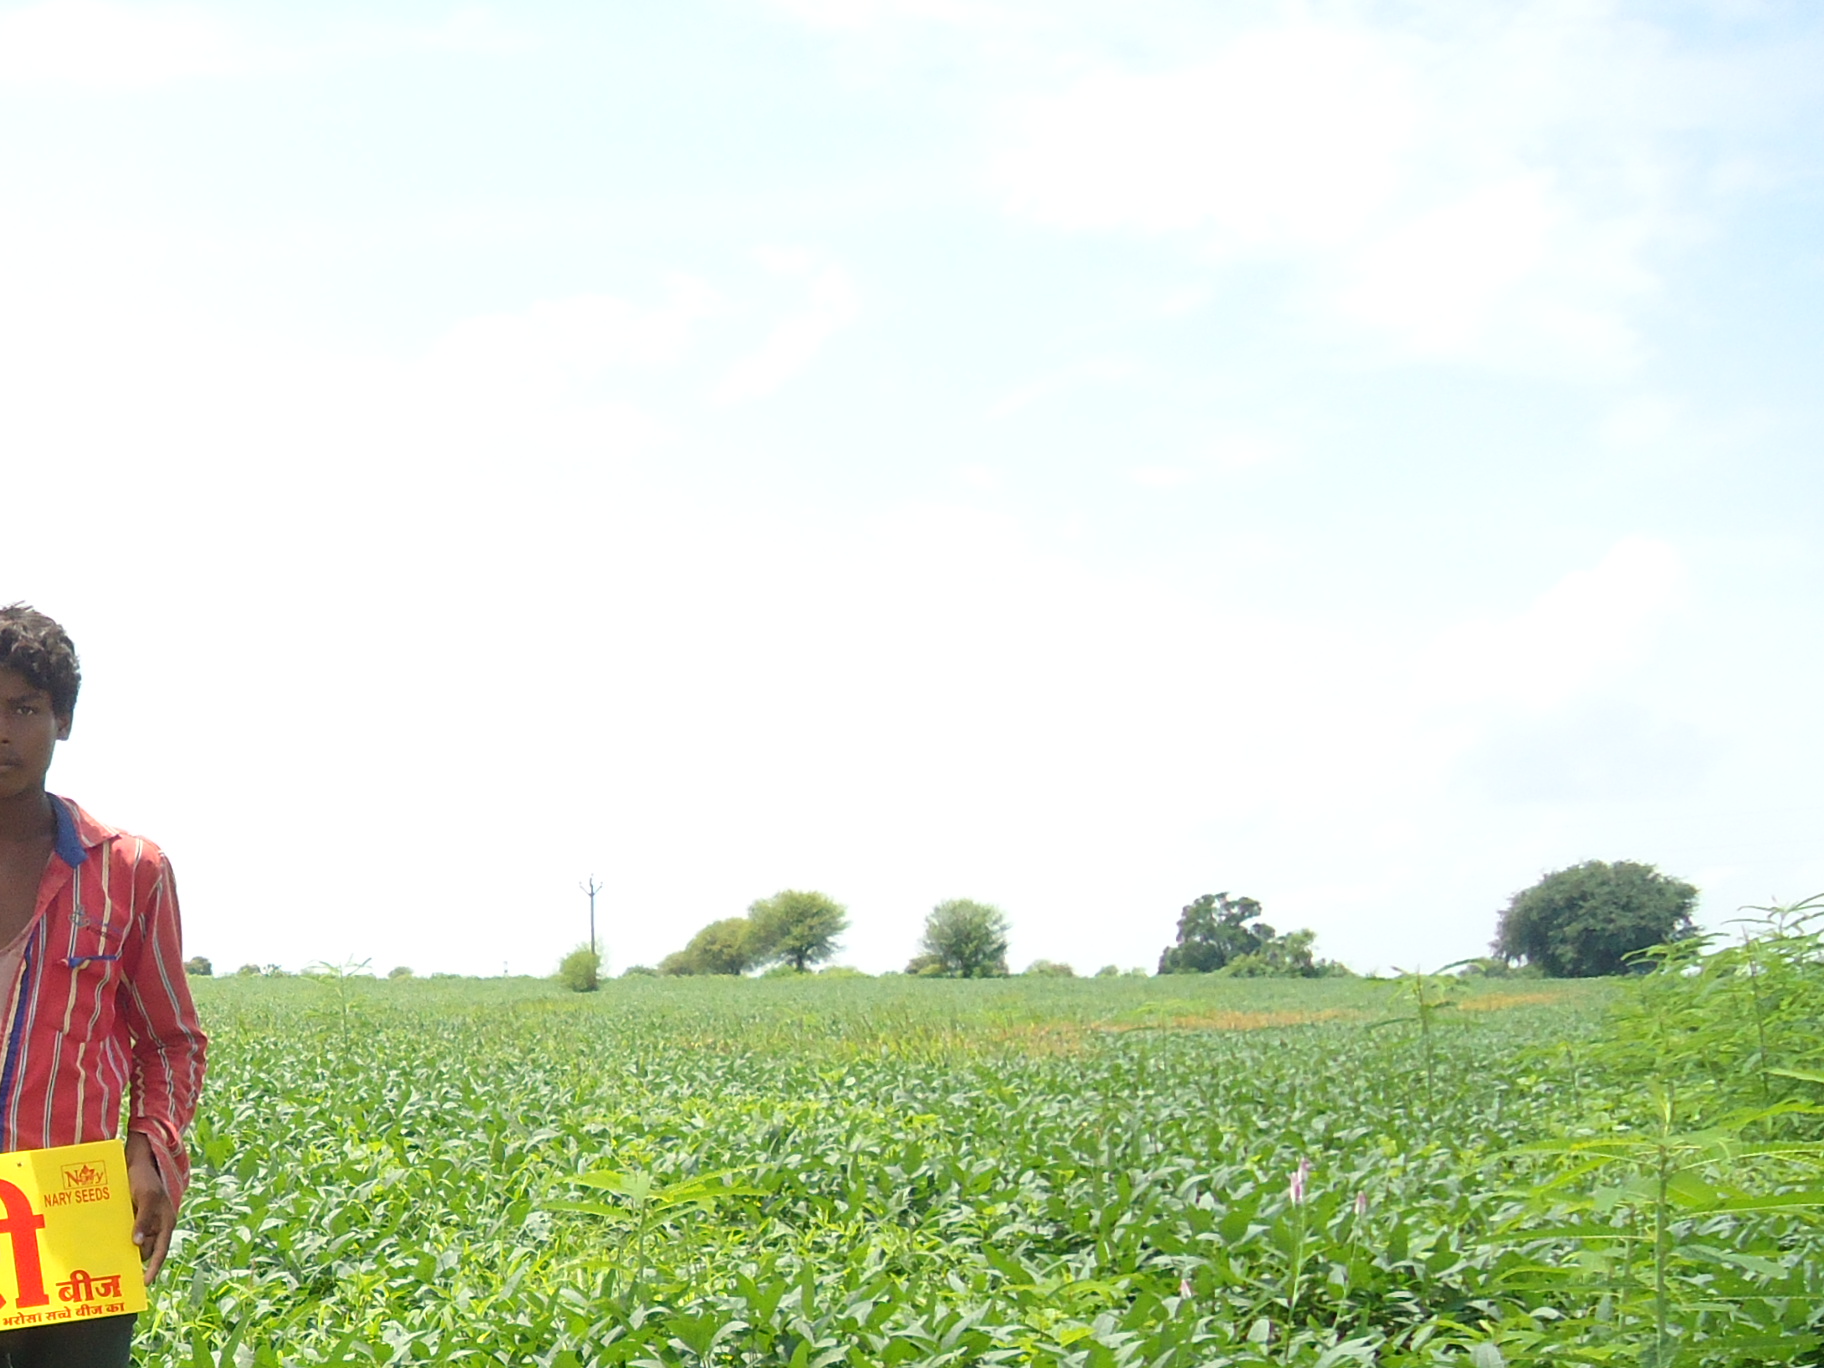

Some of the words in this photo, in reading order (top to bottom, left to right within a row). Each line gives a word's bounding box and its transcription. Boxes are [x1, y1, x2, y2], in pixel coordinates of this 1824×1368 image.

[44, 1191, 72, 1207] NARY
[75, 1187, 110, 1203] SEEDS
[56, 1270, 122, 1302] बीज
[3, 1312, 42, 1326] भरोसा
[76, 1303, 102, 1316] बीज
[106, 1302, 125, 1312] का
